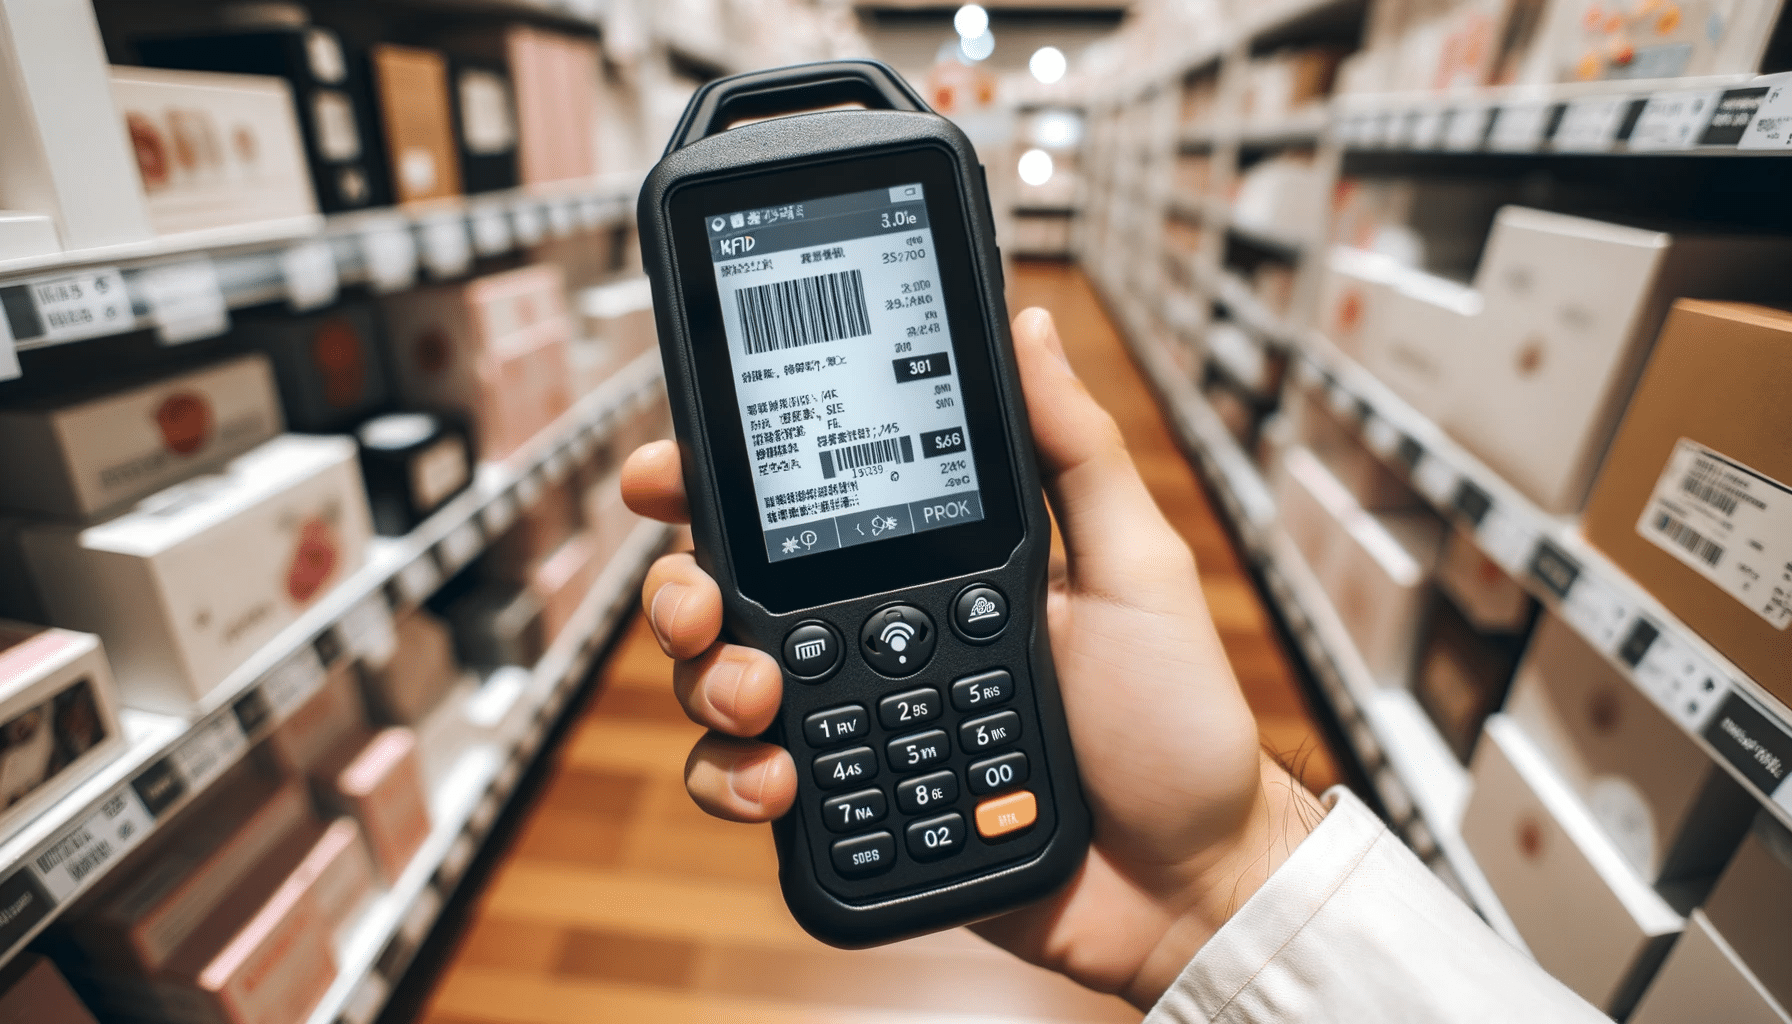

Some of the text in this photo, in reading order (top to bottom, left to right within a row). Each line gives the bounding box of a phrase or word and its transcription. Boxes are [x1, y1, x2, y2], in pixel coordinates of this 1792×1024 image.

[923, 500, 971, 524] PROK
[969, 684, 982, 704] 5
[898, 702, 912, 721] 2
[819, 719, 831, 738] 1
[976, 725, 990, 746] 6
[906, 744, 920, 765] 5
[915, 785, 929, 805] 8
[838, 803, 851, 824] 7
[924, 826, 953, 848] 02
